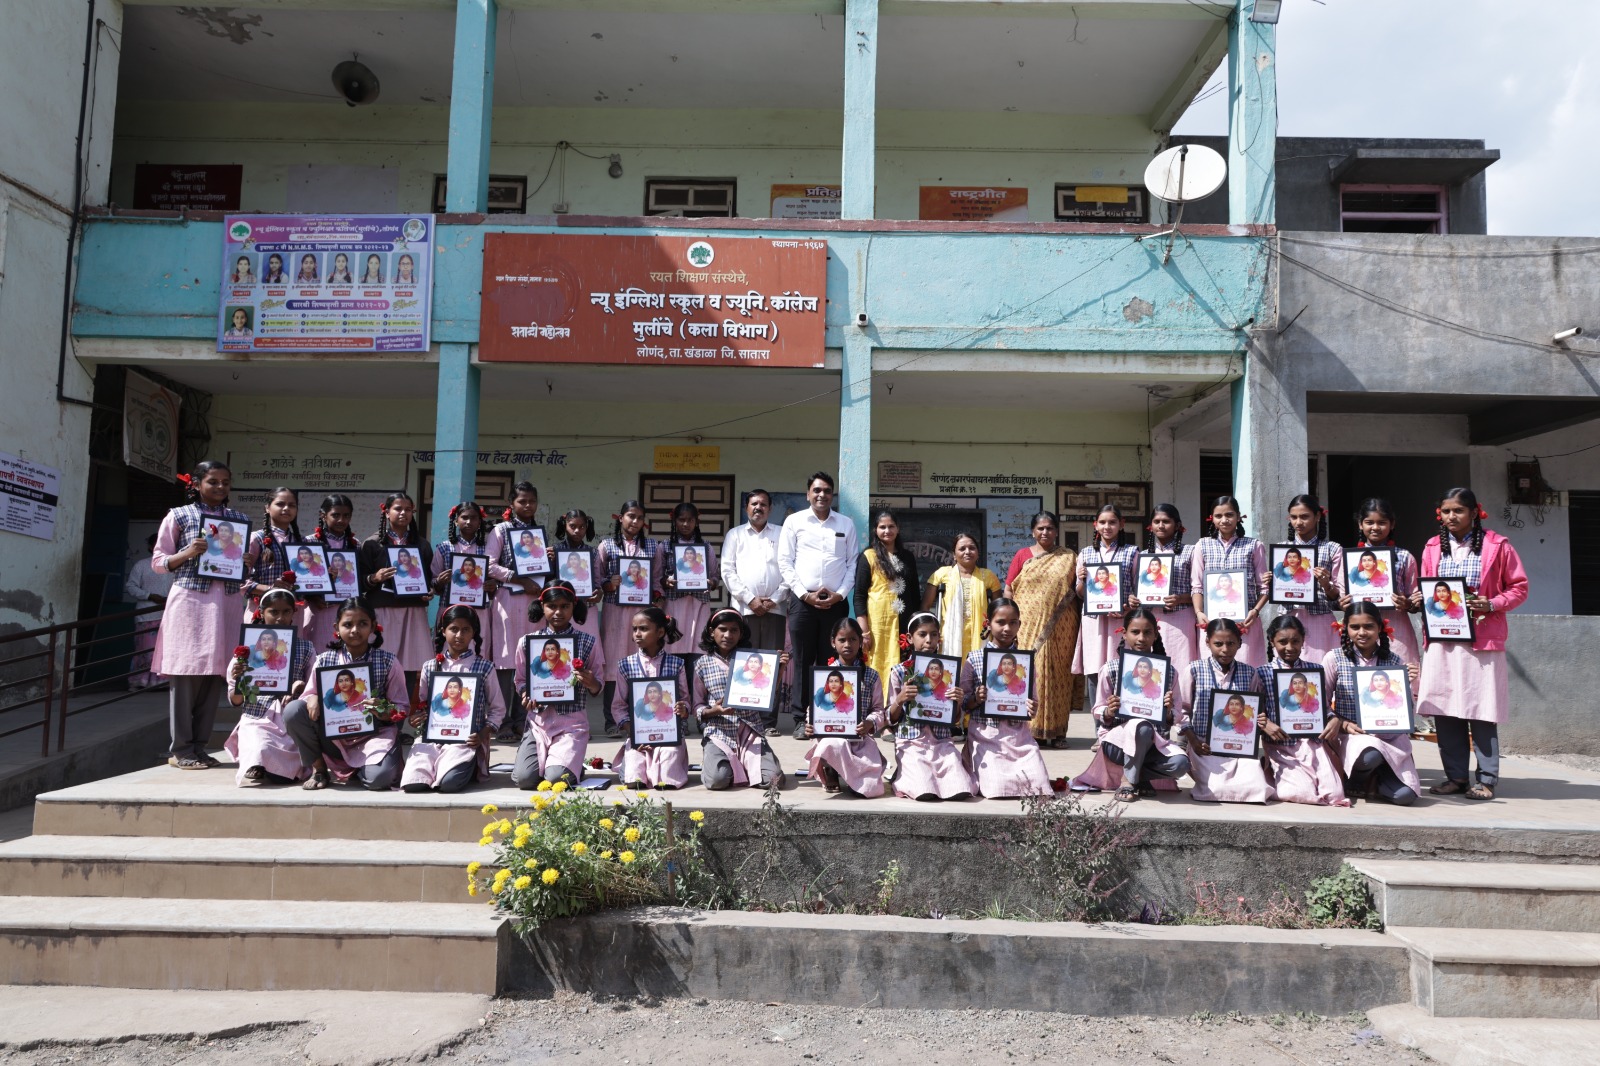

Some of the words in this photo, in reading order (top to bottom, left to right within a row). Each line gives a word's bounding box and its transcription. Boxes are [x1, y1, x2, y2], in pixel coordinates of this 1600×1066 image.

[949, 188, 1007, 200] राष्ट्रगीत
[650, 272, 673, 283] रयत
[676, 269, 709, 284] शिक्षण
[712, 269, 750, 285] संस्थेचे,
[590, 292, 614, 315] न्यू
[614, 287, 665, 310] इंग्लिश
[669, 293, 705, 315] स्कूल
[709, 294, 722, 309] व
[770, 291, 818, 311] कॉलेज
[633, 316, 673, 342] मुलींचे
[680, 319, 719, 341] (कला
[723, 318, 779, 343] विभाग)
[637, 344, 668, 359] लोणंद,
[669, 347, 682, 359] ता.
[684, 345, 717, 359] खंडाळा
[721, 346, 737, 359] जि.
[739, 348, 770, 360] सातारा
[270, 455, 297, 469] शाळेचे
[493, 450, 509, 464] हेच
[511, 449, 544, 465] आमचे
